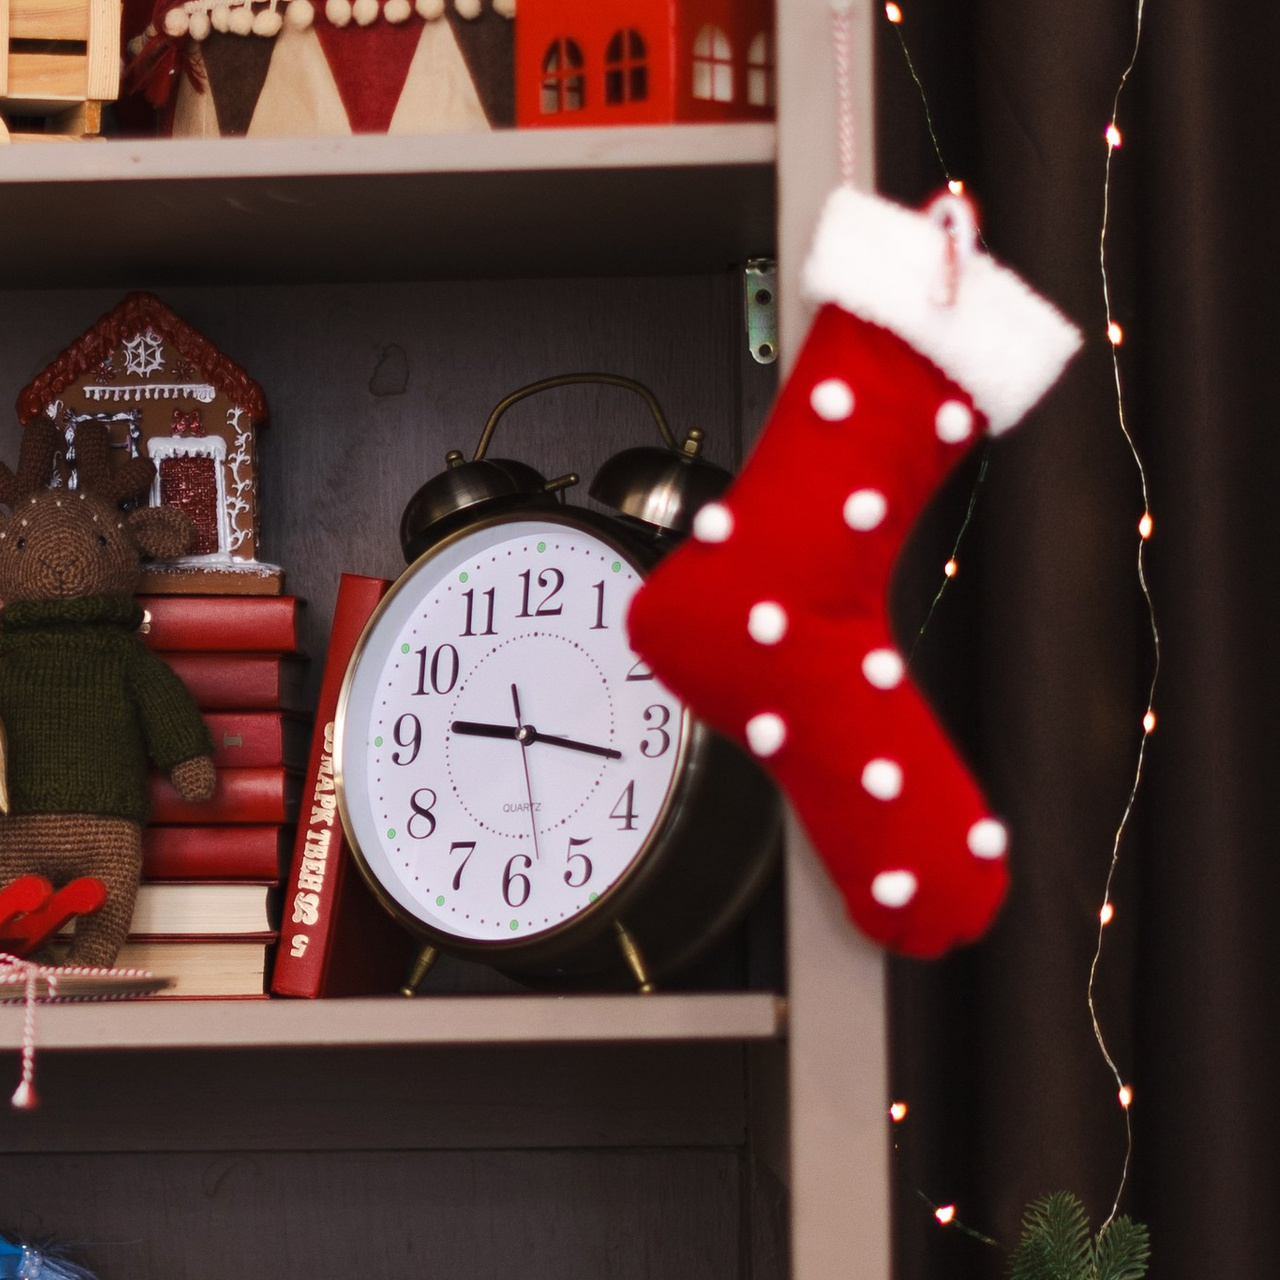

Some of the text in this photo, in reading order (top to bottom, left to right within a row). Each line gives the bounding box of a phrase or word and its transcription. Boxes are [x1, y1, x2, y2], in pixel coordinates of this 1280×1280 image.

[459, 587, 498, 636] 11
[516, 568, 564, 617] 12
[590, 580, 608, 629] 1
[412, 643, 459, 696] 10
[392, 714, 421, 766] 9
[640, 705, 670, 758] 3
[407, 788, 436, 839] 8
[610, 780, 638, 830] 4
[290, 753, 336, 958] МАРК ТВЕН 5
[450, 842, 476, 890] 7
[503, 854, 532, 907] 6
[564, 838, 592, 887] 5
